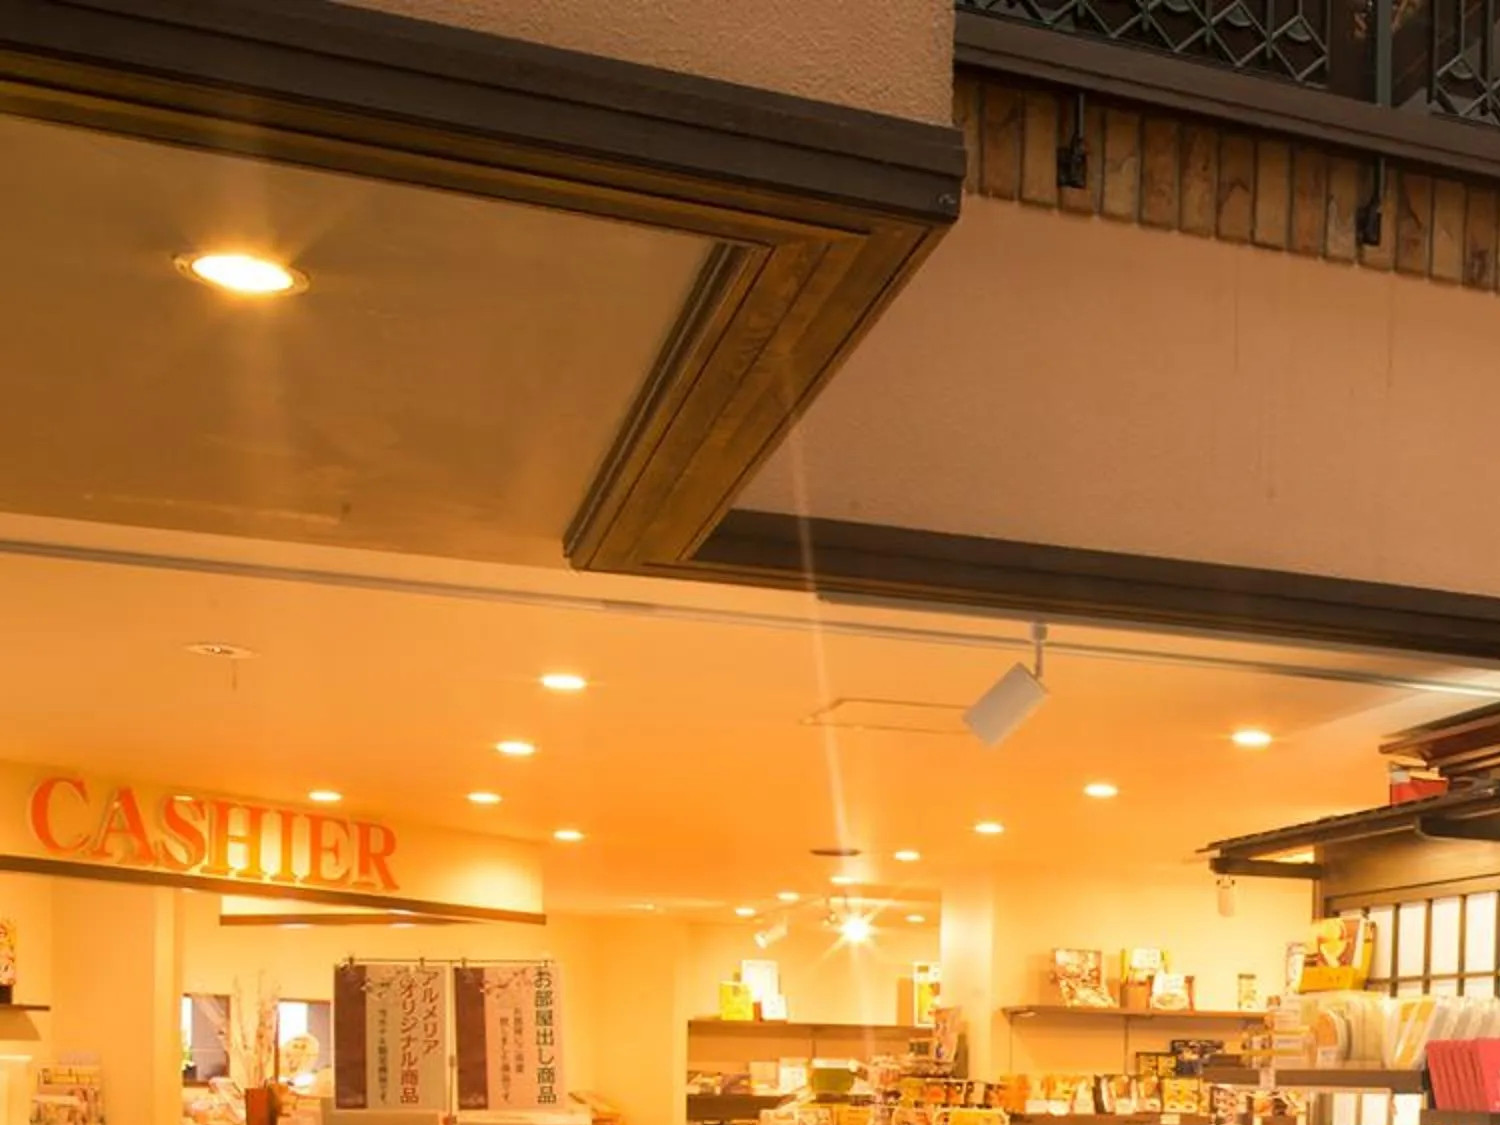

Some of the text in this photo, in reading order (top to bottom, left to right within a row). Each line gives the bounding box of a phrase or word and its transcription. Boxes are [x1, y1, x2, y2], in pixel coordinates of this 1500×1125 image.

[27, 776, 400, 891] CASHIER
[400, 976, 419, 1104] オリジナル商品
[420, 968, 440, 1056] アルメリア
[534, 968, 557, 1105] お部屋出し商品
